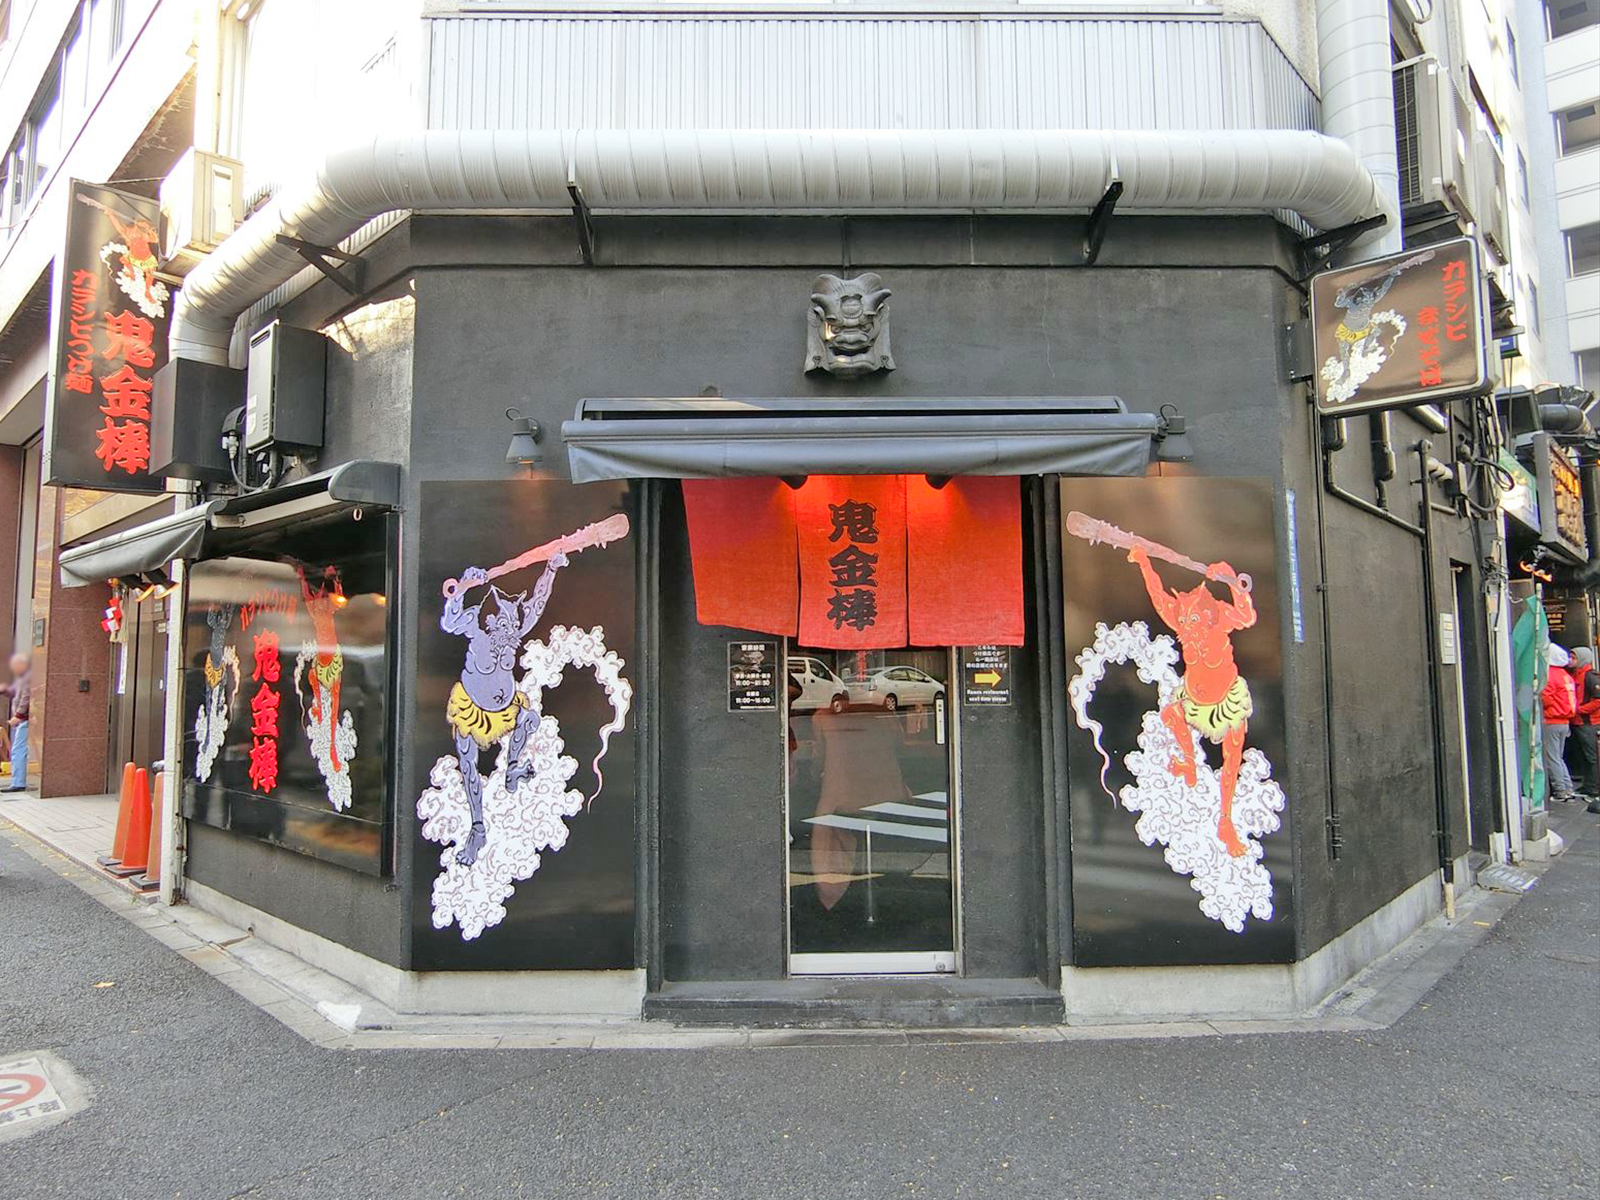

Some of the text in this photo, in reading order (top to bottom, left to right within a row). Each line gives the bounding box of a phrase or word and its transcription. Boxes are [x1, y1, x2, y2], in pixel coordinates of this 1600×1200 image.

[95, 310, 156, 476] 鬼金棒
[1417, 306, 1442, 387] まぜそば
[826, 498, 880, 632] 鬼金棒
[248, 630, 283, 795] 鬼金棒
